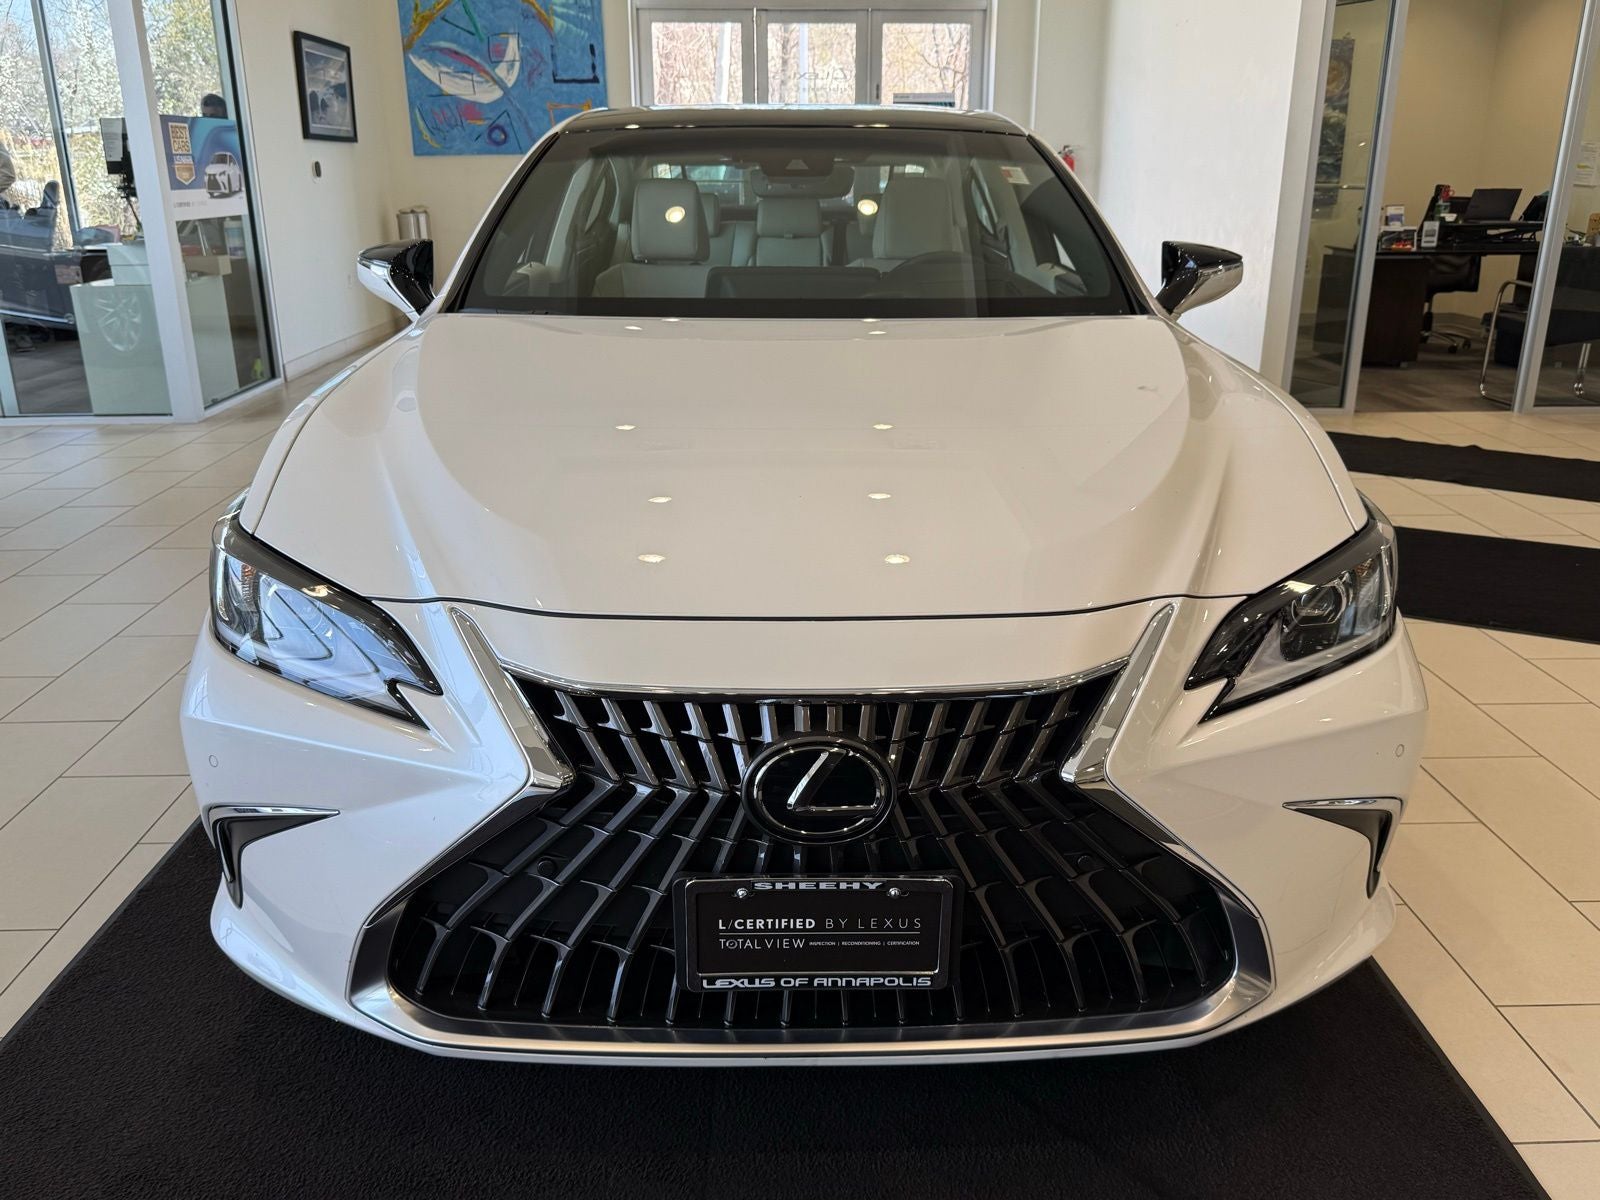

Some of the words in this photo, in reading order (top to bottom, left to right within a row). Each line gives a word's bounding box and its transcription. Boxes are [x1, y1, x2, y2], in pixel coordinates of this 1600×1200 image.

[173, 139, 191, 153] CARS
[754, 881, 883, 890] SHEEHY
[825, 918, 848, 929] BY
[858, 918, 921, 929] LEXUS
[719, 938, 762, 950] TOTAL
[764, 938, 806, 949] VIEW
[702, 977, 776, 989] LEXUS
[780, 977, 809, 987] OF
[813, 976, 932, 988] ANNAPOLIS
